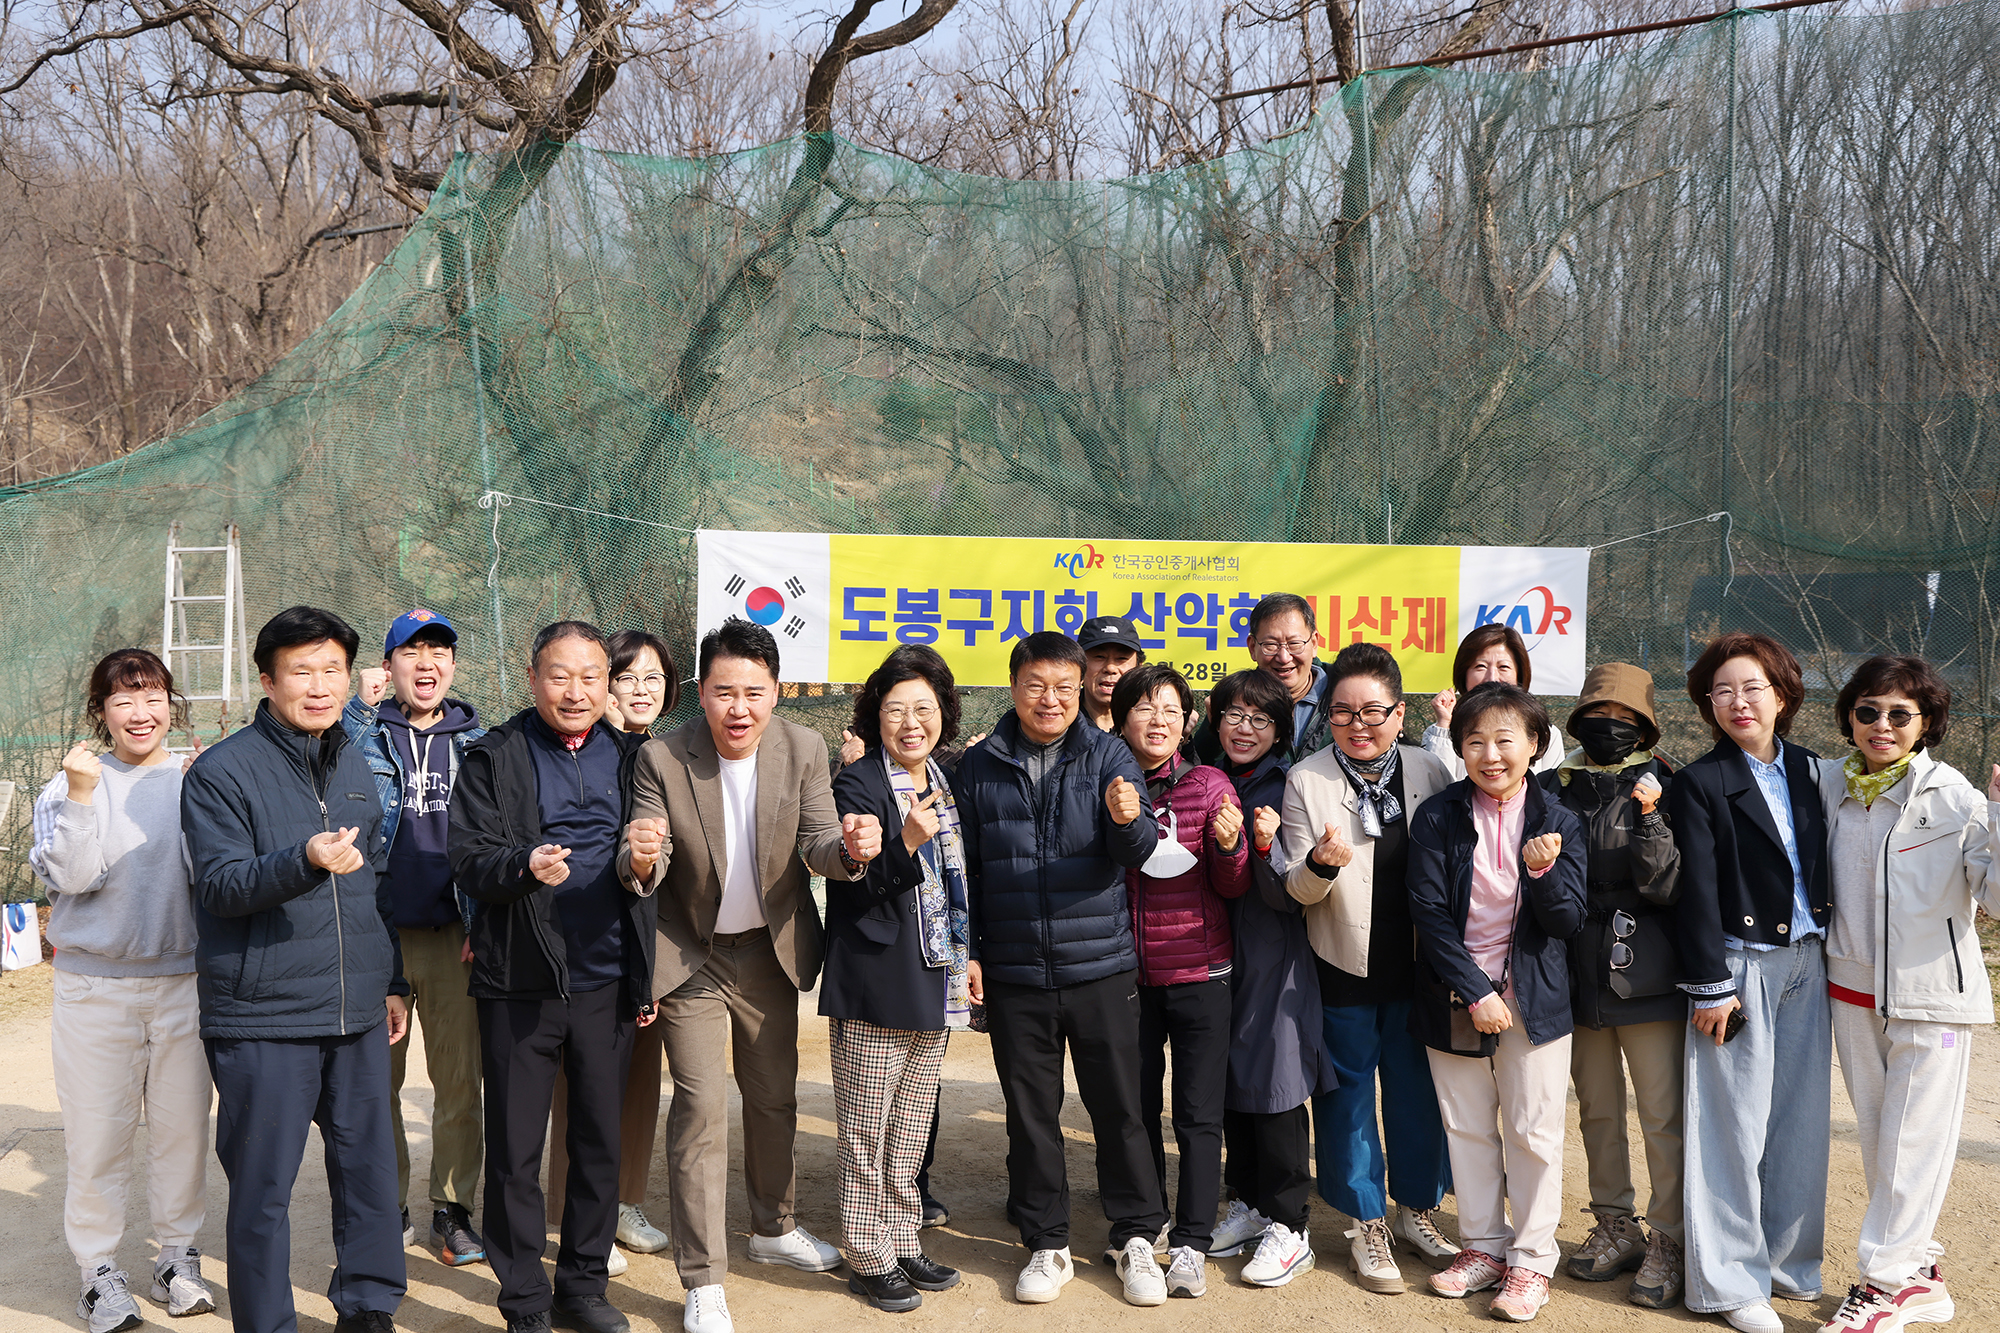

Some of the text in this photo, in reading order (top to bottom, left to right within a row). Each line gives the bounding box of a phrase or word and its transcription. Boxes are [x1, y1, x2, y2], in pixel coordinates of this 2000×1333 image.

[1053, 543, 1105, 579] KAR
[1112, 553, 1240, 571] 한국공인중개사협회
[1112, 571, 1239, 582] Korea Association of Realestators
[840, 586, 1098, 647] 도봉구지회
[1306, 595, 1446, 653] 시산제
[1473, 586, 1572, 636] KAR
[1182, 662, 1228, 682] 28일
[1686, 981, 1726, 993] AMETHYST
